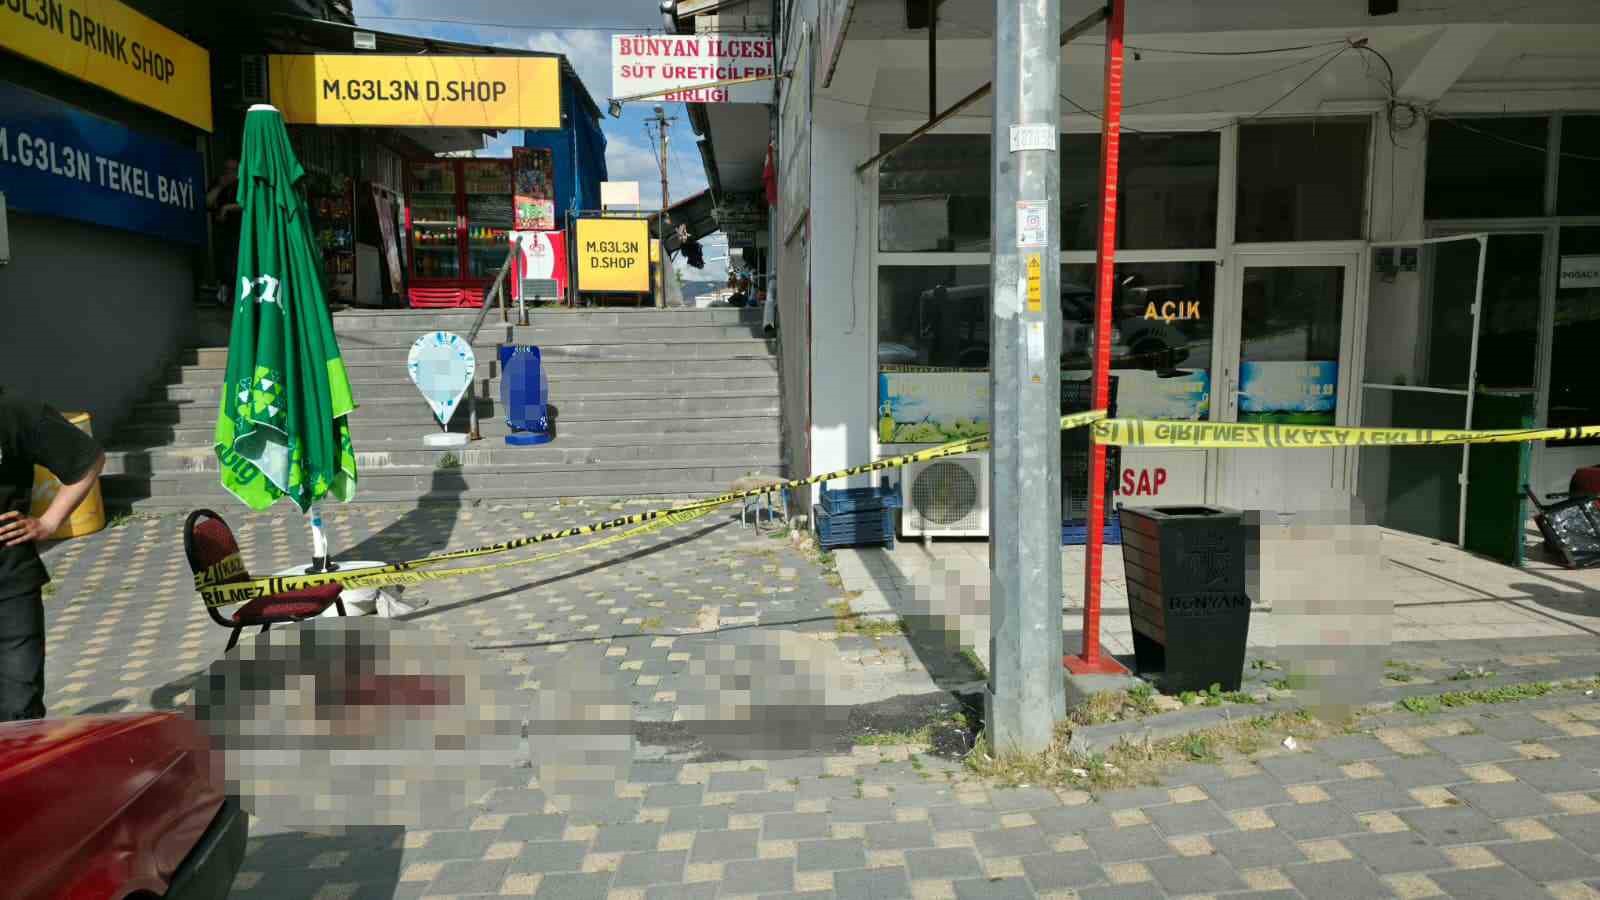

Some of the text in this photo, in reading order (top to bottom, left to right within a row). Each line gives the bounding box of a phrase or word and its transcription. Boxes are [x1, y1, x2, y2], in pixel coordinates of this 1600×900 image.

[69, 8, 129, 65] DRINK
[131, 41, 176, 84] SHOP
[619, 35, 700, 57] BÜNYAN
[621, 61, 657, 79] SÜT
[323, 79, 507, 102] M.G3L3N D.SHOP
[96, 155, 154, 200] TEKEL
[158, 175, 195, 210] BAYİ
[586, 241, 639, 253] M.G3L3N
[591, 256, 635, 269] D.SHOP
[1144, 301, 1200, 324] AÇIK
[1114, 468, 1167, 497] SAP
